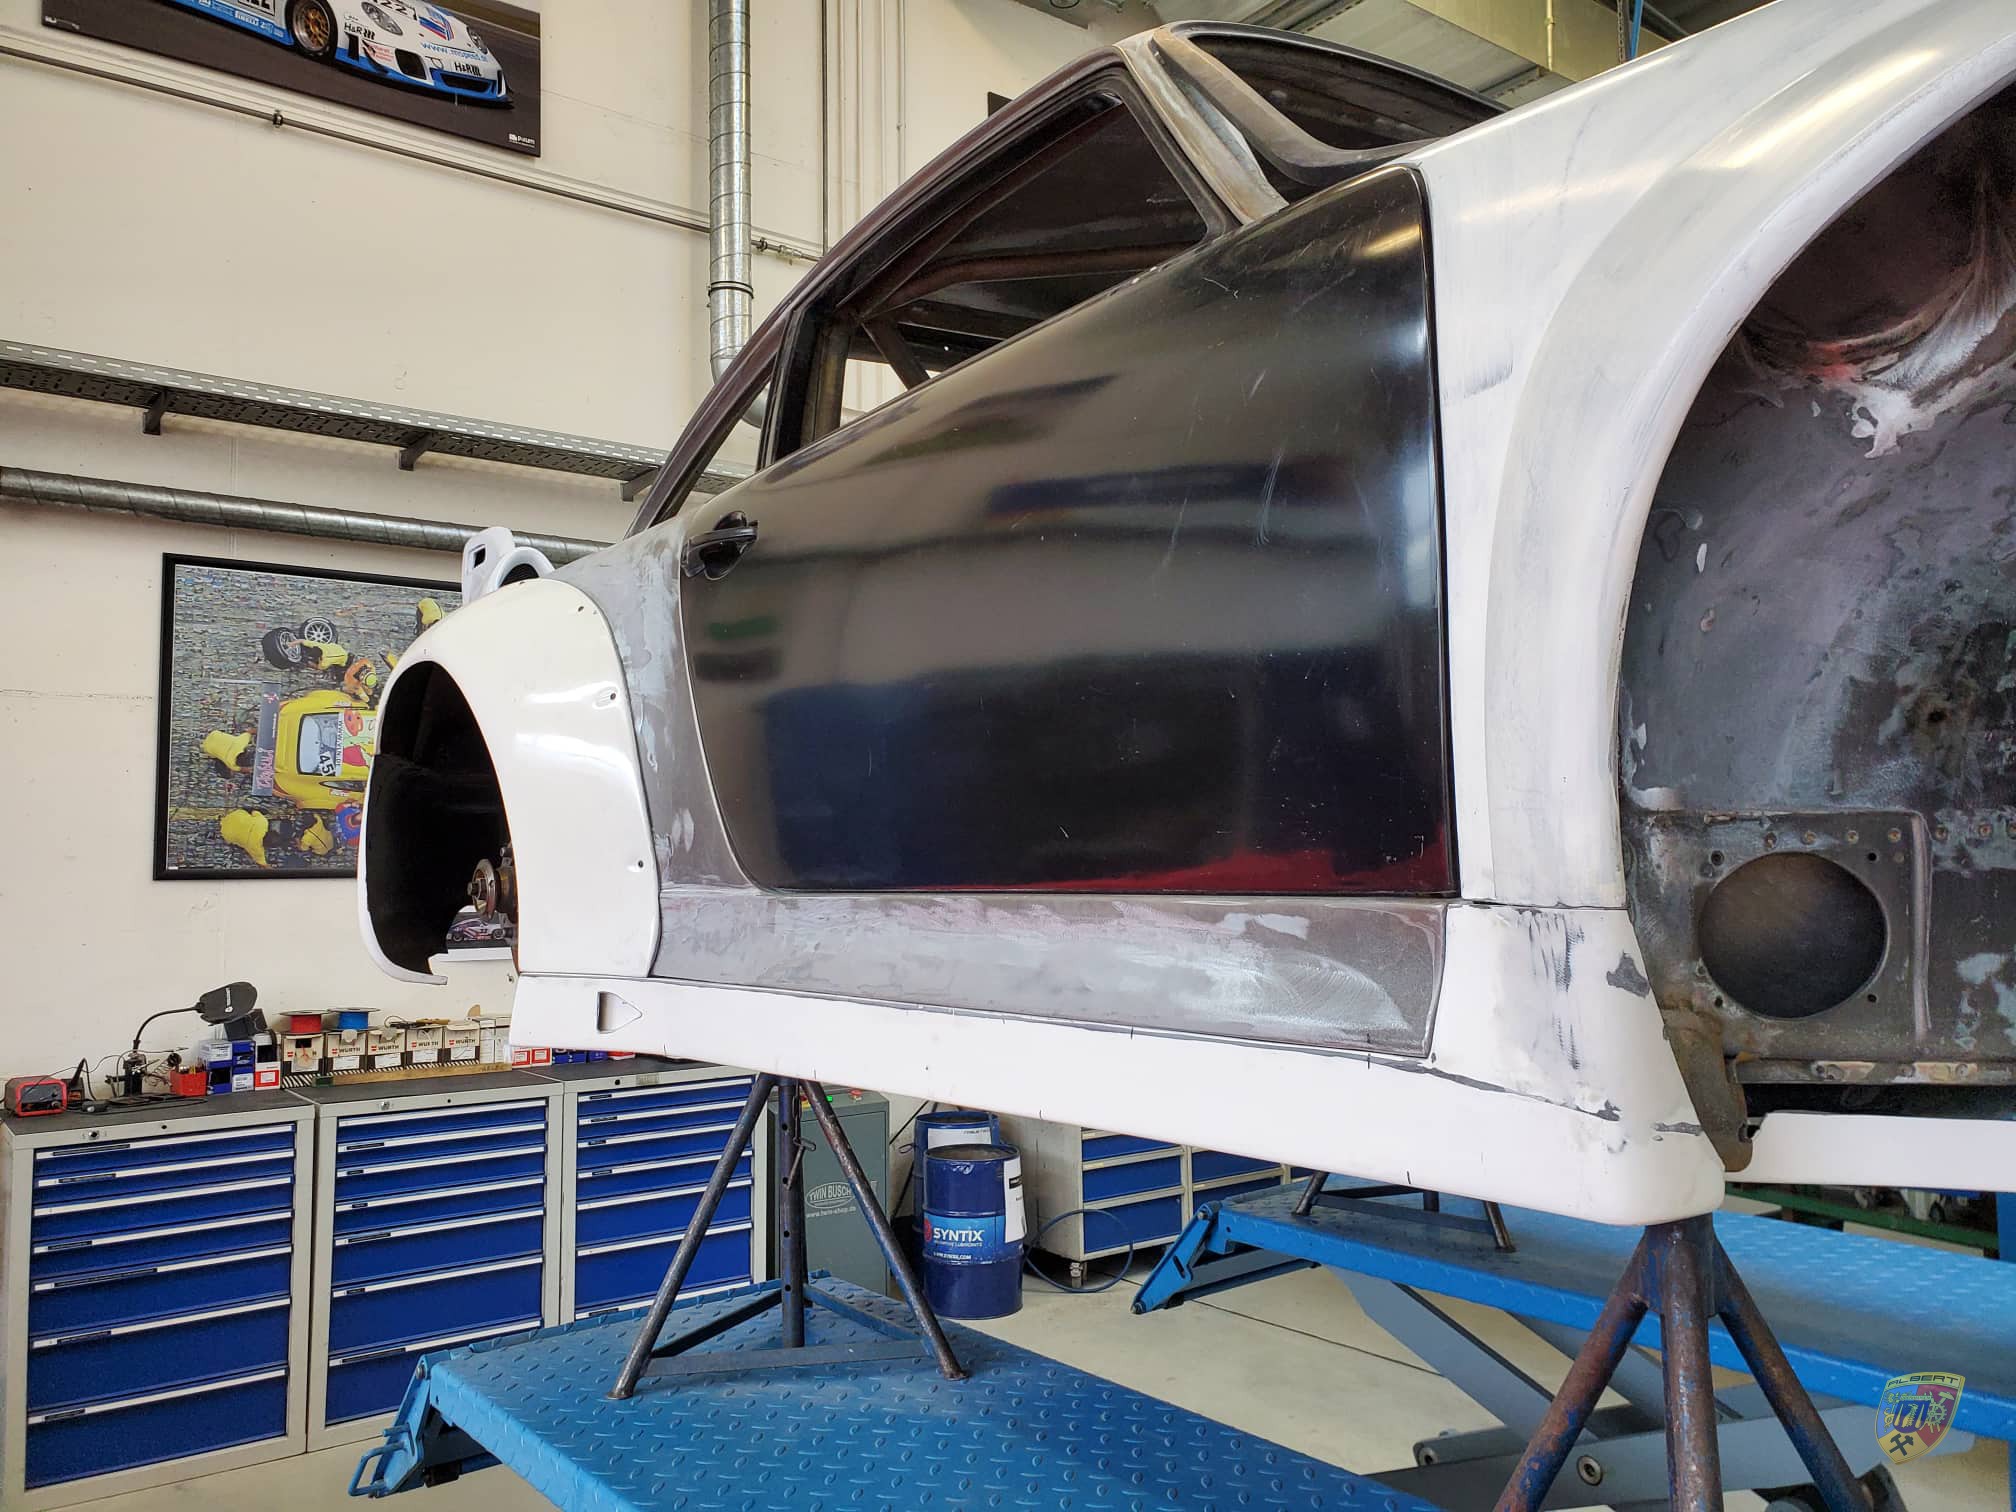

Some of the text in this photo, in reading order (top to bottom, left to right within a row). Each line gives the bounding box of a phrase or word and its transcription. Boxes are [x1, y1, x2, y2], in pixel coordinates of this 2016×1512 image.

[320, 755, 334, 774] 45
[810, 1184, 851, 1200] TWIN BUSCH
[933, 1227, 986, 1242] SYNTIX
